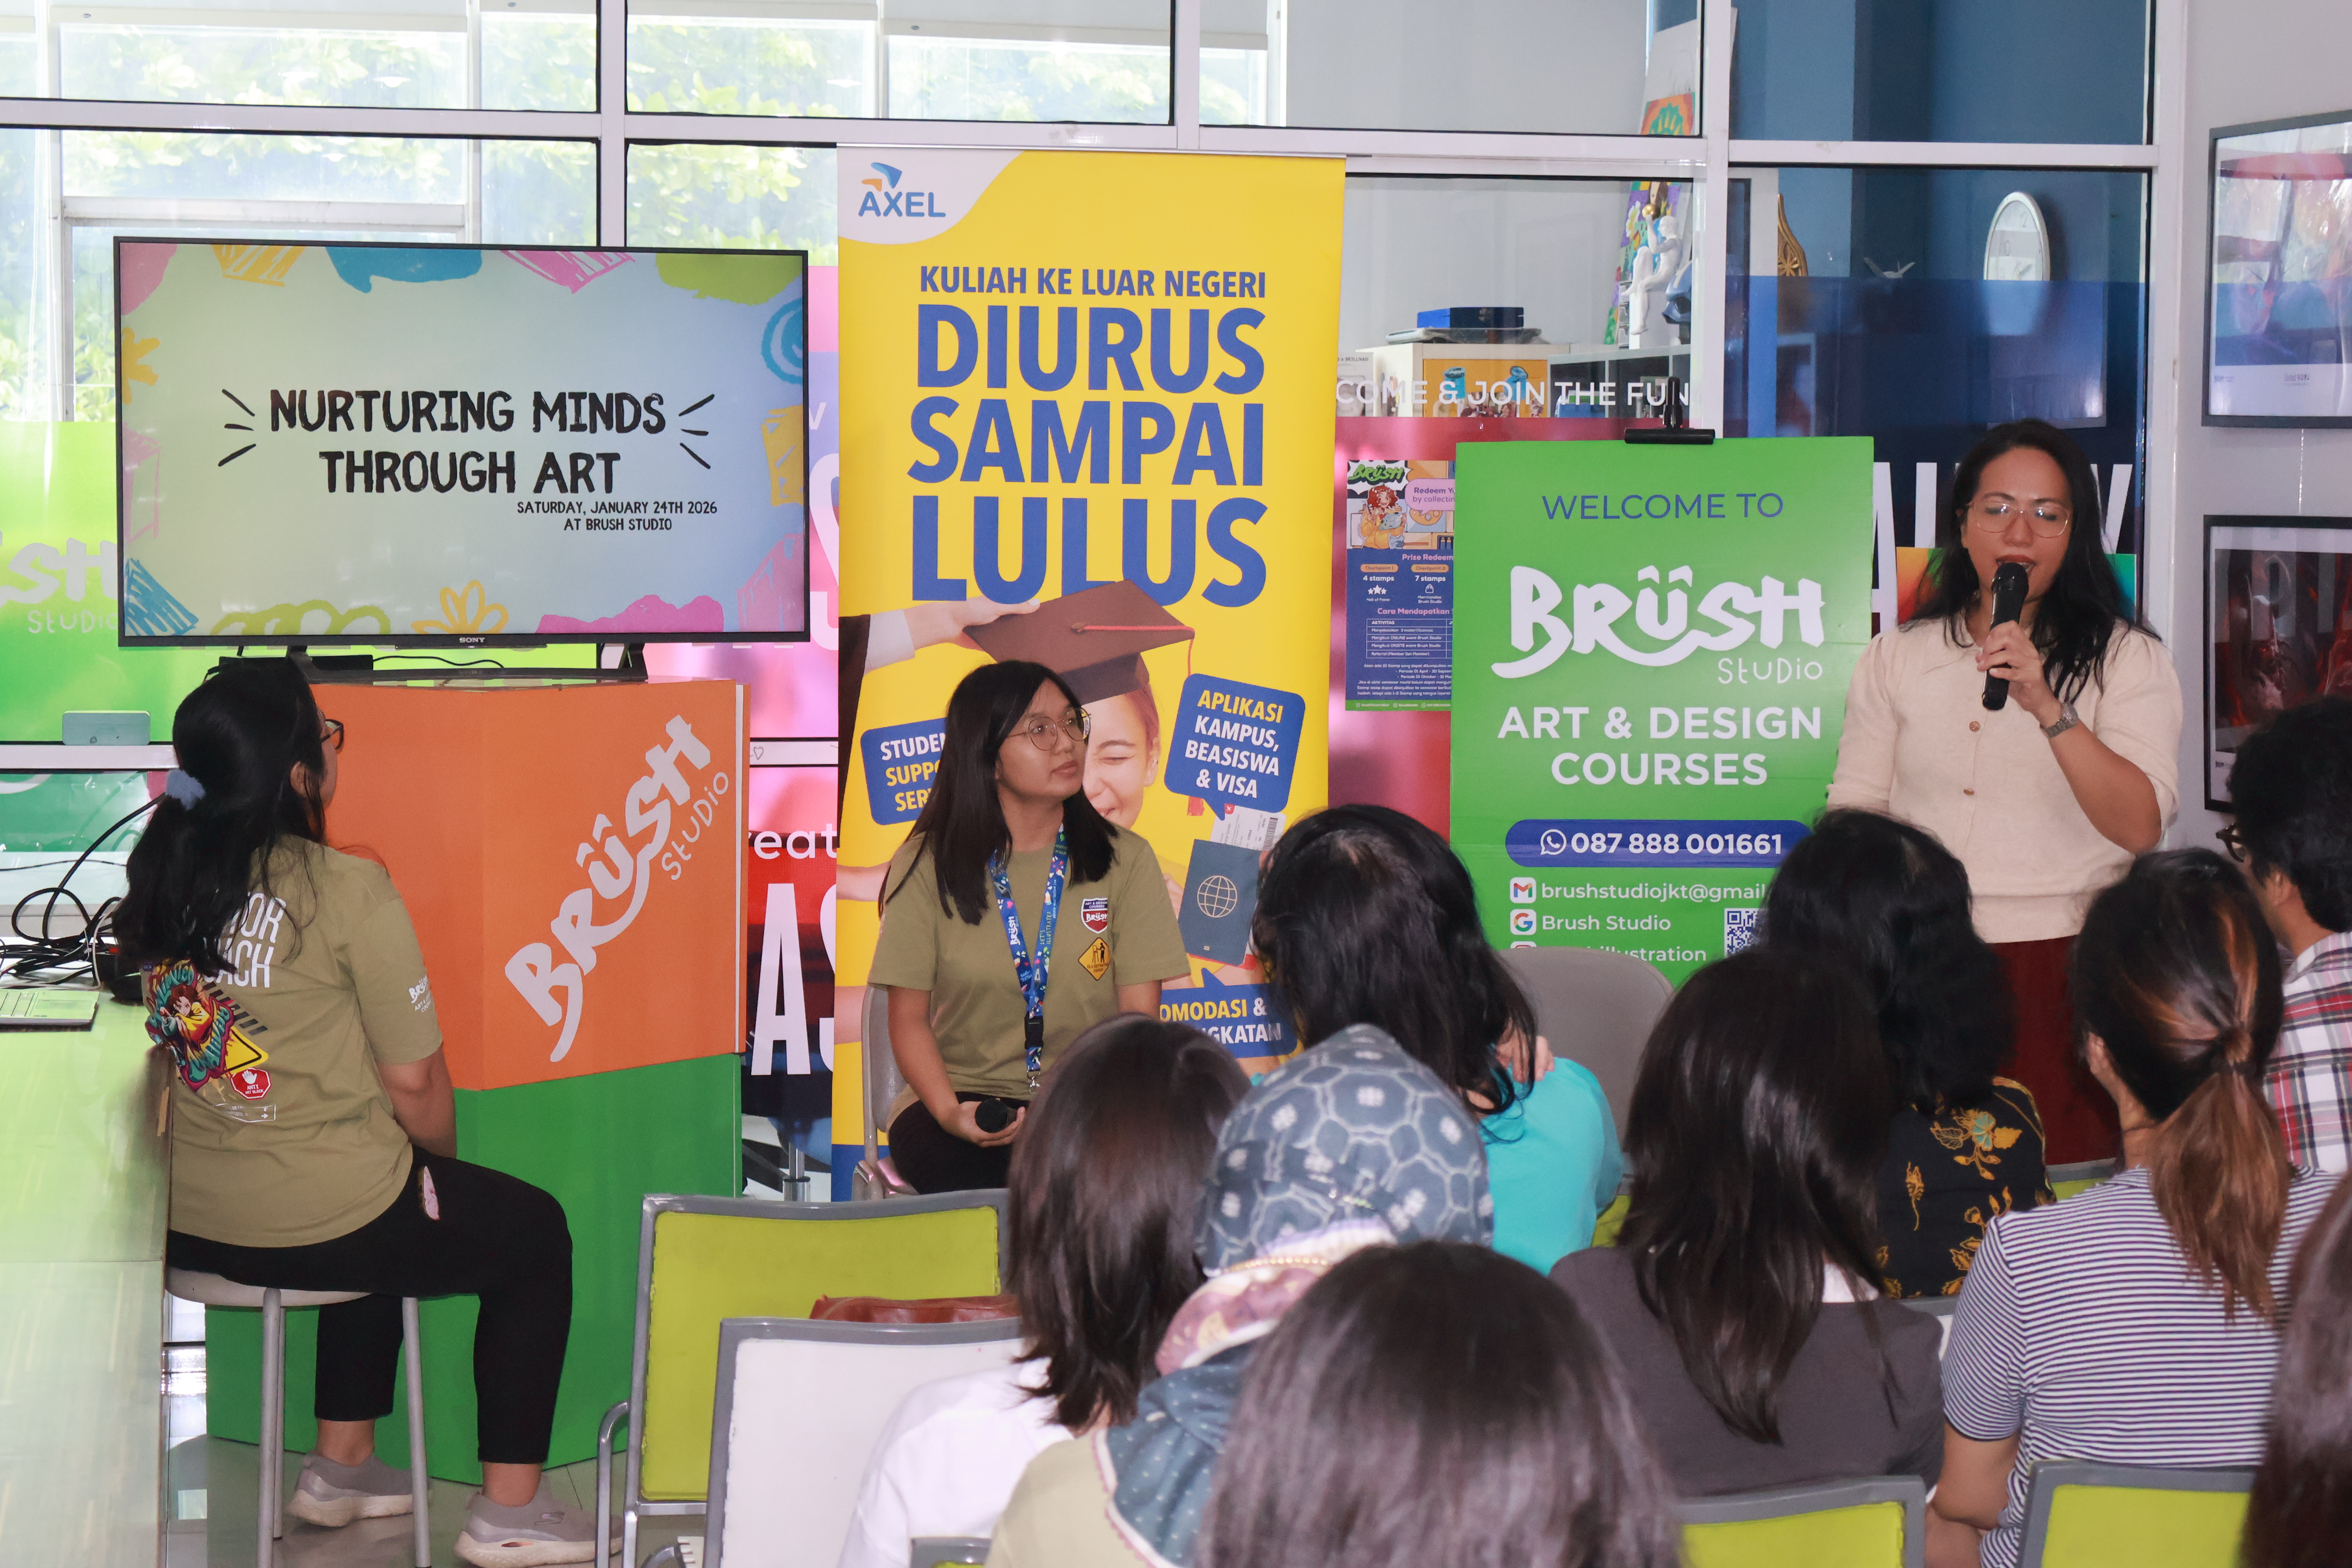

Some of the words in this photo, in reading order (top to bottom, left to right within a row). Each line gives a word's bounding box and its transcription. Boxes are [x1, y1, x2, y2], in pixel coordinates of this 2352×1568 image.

[858, 191, 946, 217] AXEL
[920, 266, 1026, 294] KULIAH
[1037, 268, 1072, 295] KE
[1082, 269, 1155, 296] LUAR
[1165, 270, 1266, 298] NEGERI
[917, 304, 1266, 395] DIURUS
[1439, 381, 1458, 405] &
[1468, 381, 1545, 406] JOIN
[1555, 382, 1616, 406] THE
[270, 389, 514, 432] NURTURING
[532, 391, 666, 434] MINDS
[907, 396, 1263, 486] SAMPAI
[319, 450, 515, 494] THROUGH
[533, 451, 621, 494] ART
[517, 501, 586, 515] SATURDAY,
[590, 501, 648, 514] JANUARY
[653, 502, 683, 514] 24TH
[688, 502, 717, 514] 2026
[1542, 494, 1725, 519] WELCOME
[1736, 493, 1784, 518] TO
[564, 518, 581, 530] AT
[586, 518, 624, 530] BRUSH
[628, 518, 672, 530] STUDIO
[912, 495, 1268, 608] LULUS
[1397, 608, 1450, 616] Mendapatkan
[1197, 690, 1283, 723] APLIKASI
[1497, 706, 1589, 739] ART
[1604, 706, 1632, 739] &
[1650, 706, 1821, 739] DESIGN
[1195, 715, 1279, 752] KAMPUS,
[1185, 740, 1279, 776] BEASISWA
[1551, 752, 1768, 785] COURSES
[1196, 769, 1211, 789] &
[1217, 772, 1258, 799] VISA
[1571, 833, 1622, 854] 087
[1628, 833, 1680, 855] 888
[1686, 833, 1782, 855] 001661
[1542, 915, 1600, 931] Brush
[1606, 915, 1671, 931] Studio
[1253, 997, 1267, 1016] &
